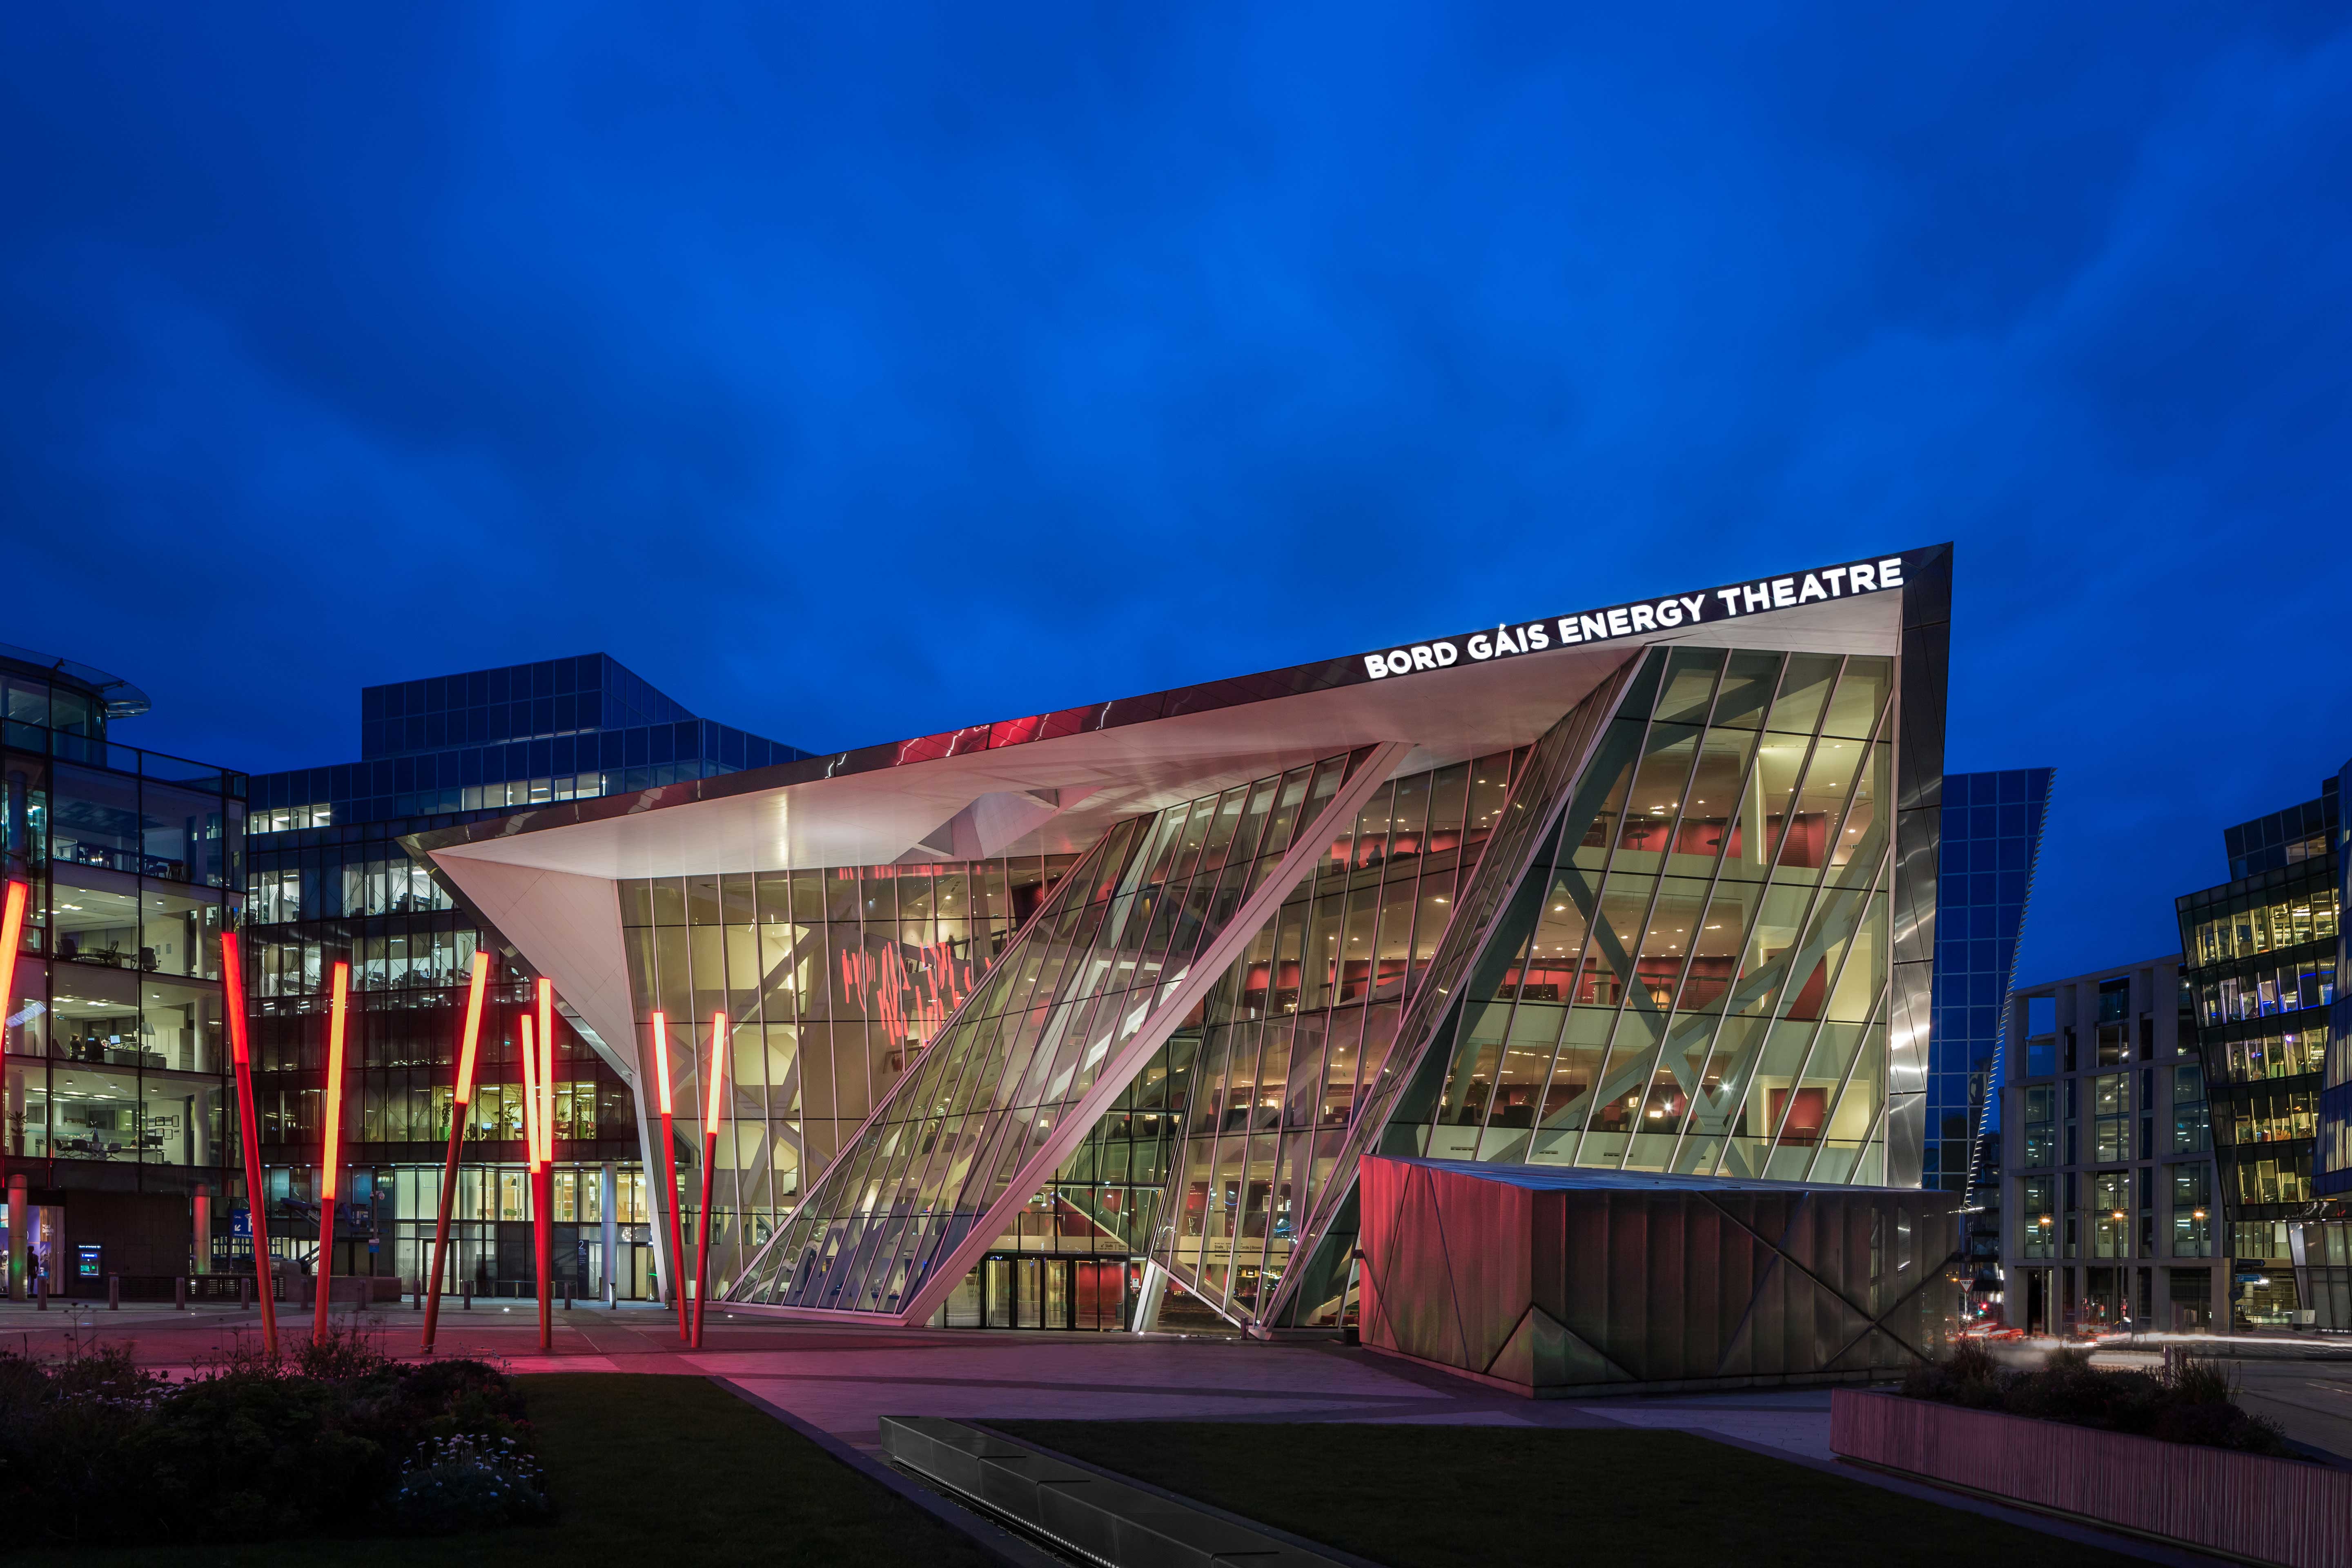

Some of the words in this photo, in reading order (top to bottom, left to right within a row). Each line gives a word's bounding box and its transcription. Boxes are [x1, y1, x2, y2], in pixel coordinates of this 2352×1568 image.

[1364, 641, 1458, 679] BORD
[1467, 624, 1549, 660] GÁIS
[1558, 594, 1706, 644] ENERGY
[1717, 557, 1904, 616] THEATRE
[579, 1241, 584, 1249] 2
